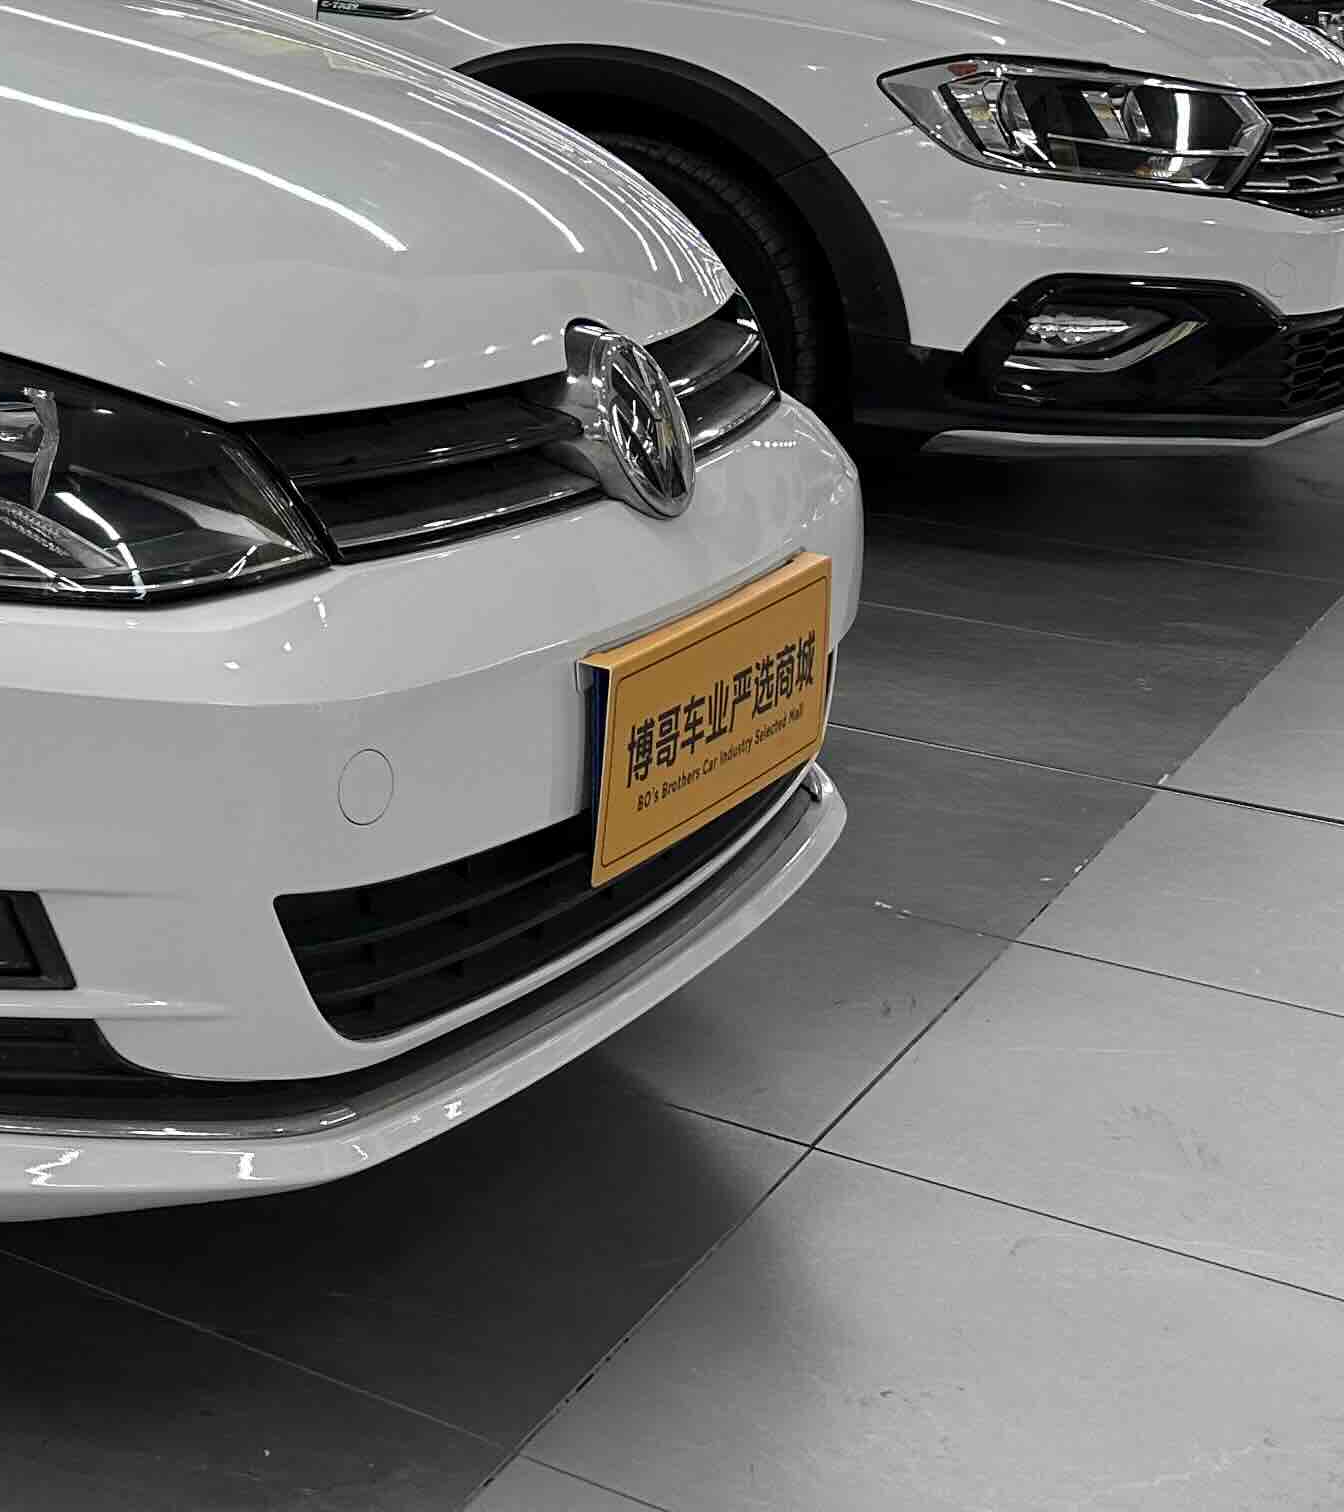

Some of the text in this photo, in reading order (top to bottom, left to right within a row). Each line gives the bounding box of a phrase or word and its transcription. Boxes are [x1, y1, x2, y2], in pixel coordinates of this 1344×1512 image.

[627, 630, 816, 789] 博哥车业严选商城
